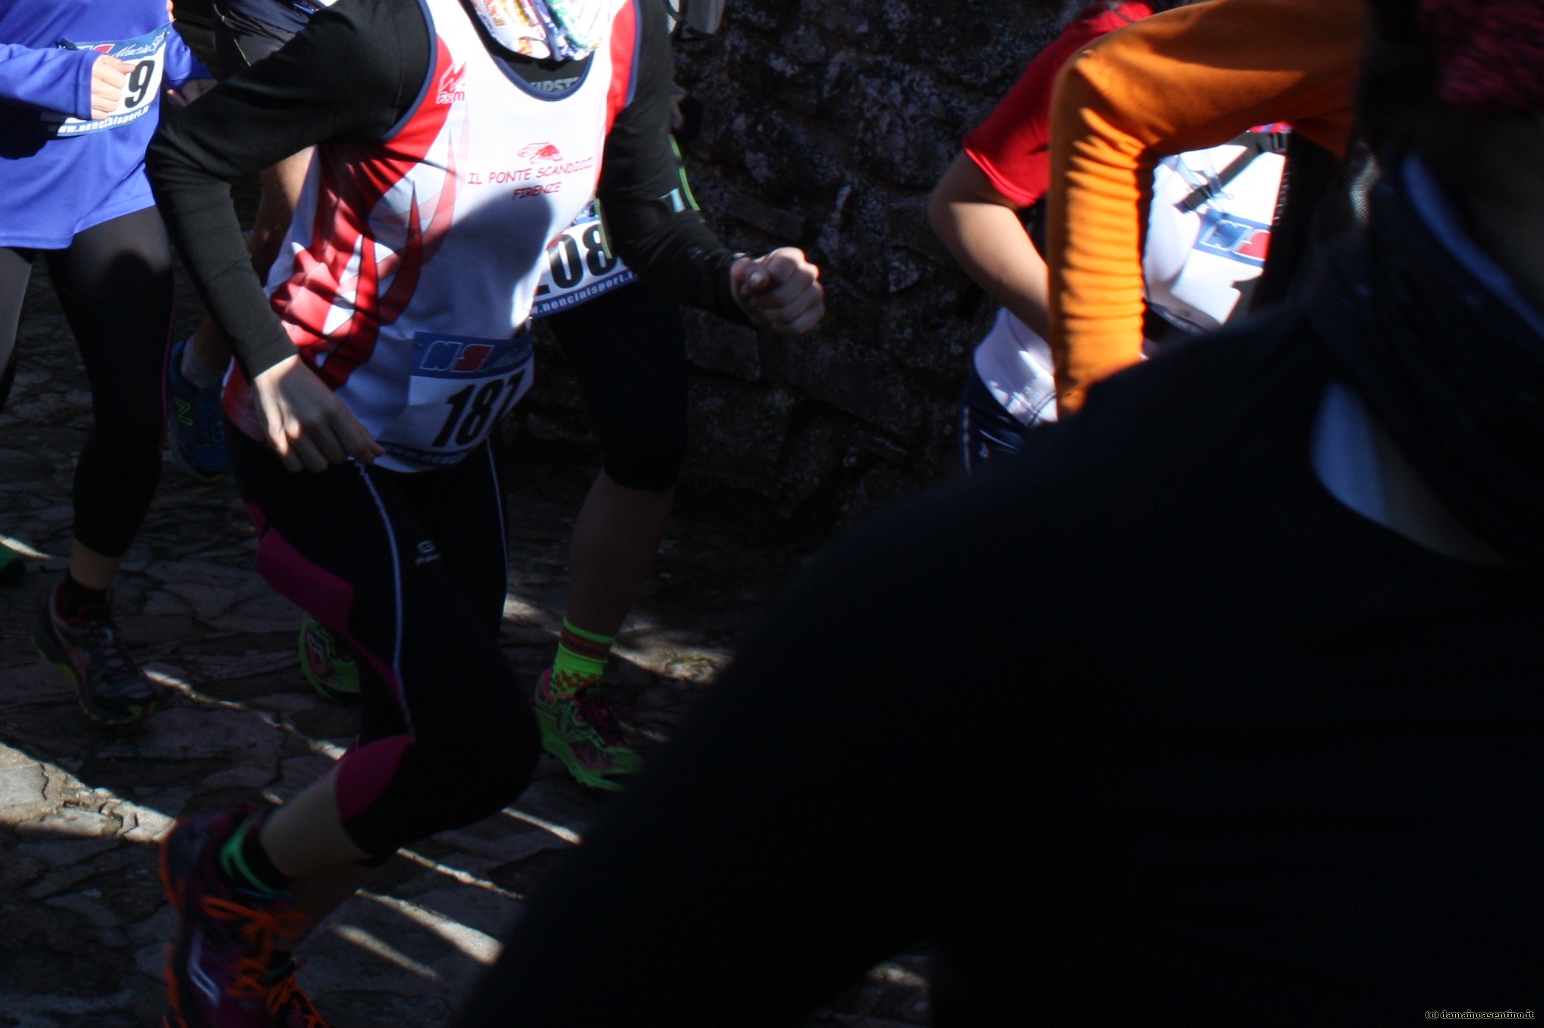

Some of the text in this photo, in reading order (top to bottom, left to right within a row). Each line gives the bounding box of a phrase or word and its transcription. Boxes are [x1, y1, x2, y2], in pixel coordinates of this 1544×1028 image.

[468, 173, 483, 185] IL
[488, 168, 533, 185] PONTE
[512, 181, 562, 200] FIRENZE
